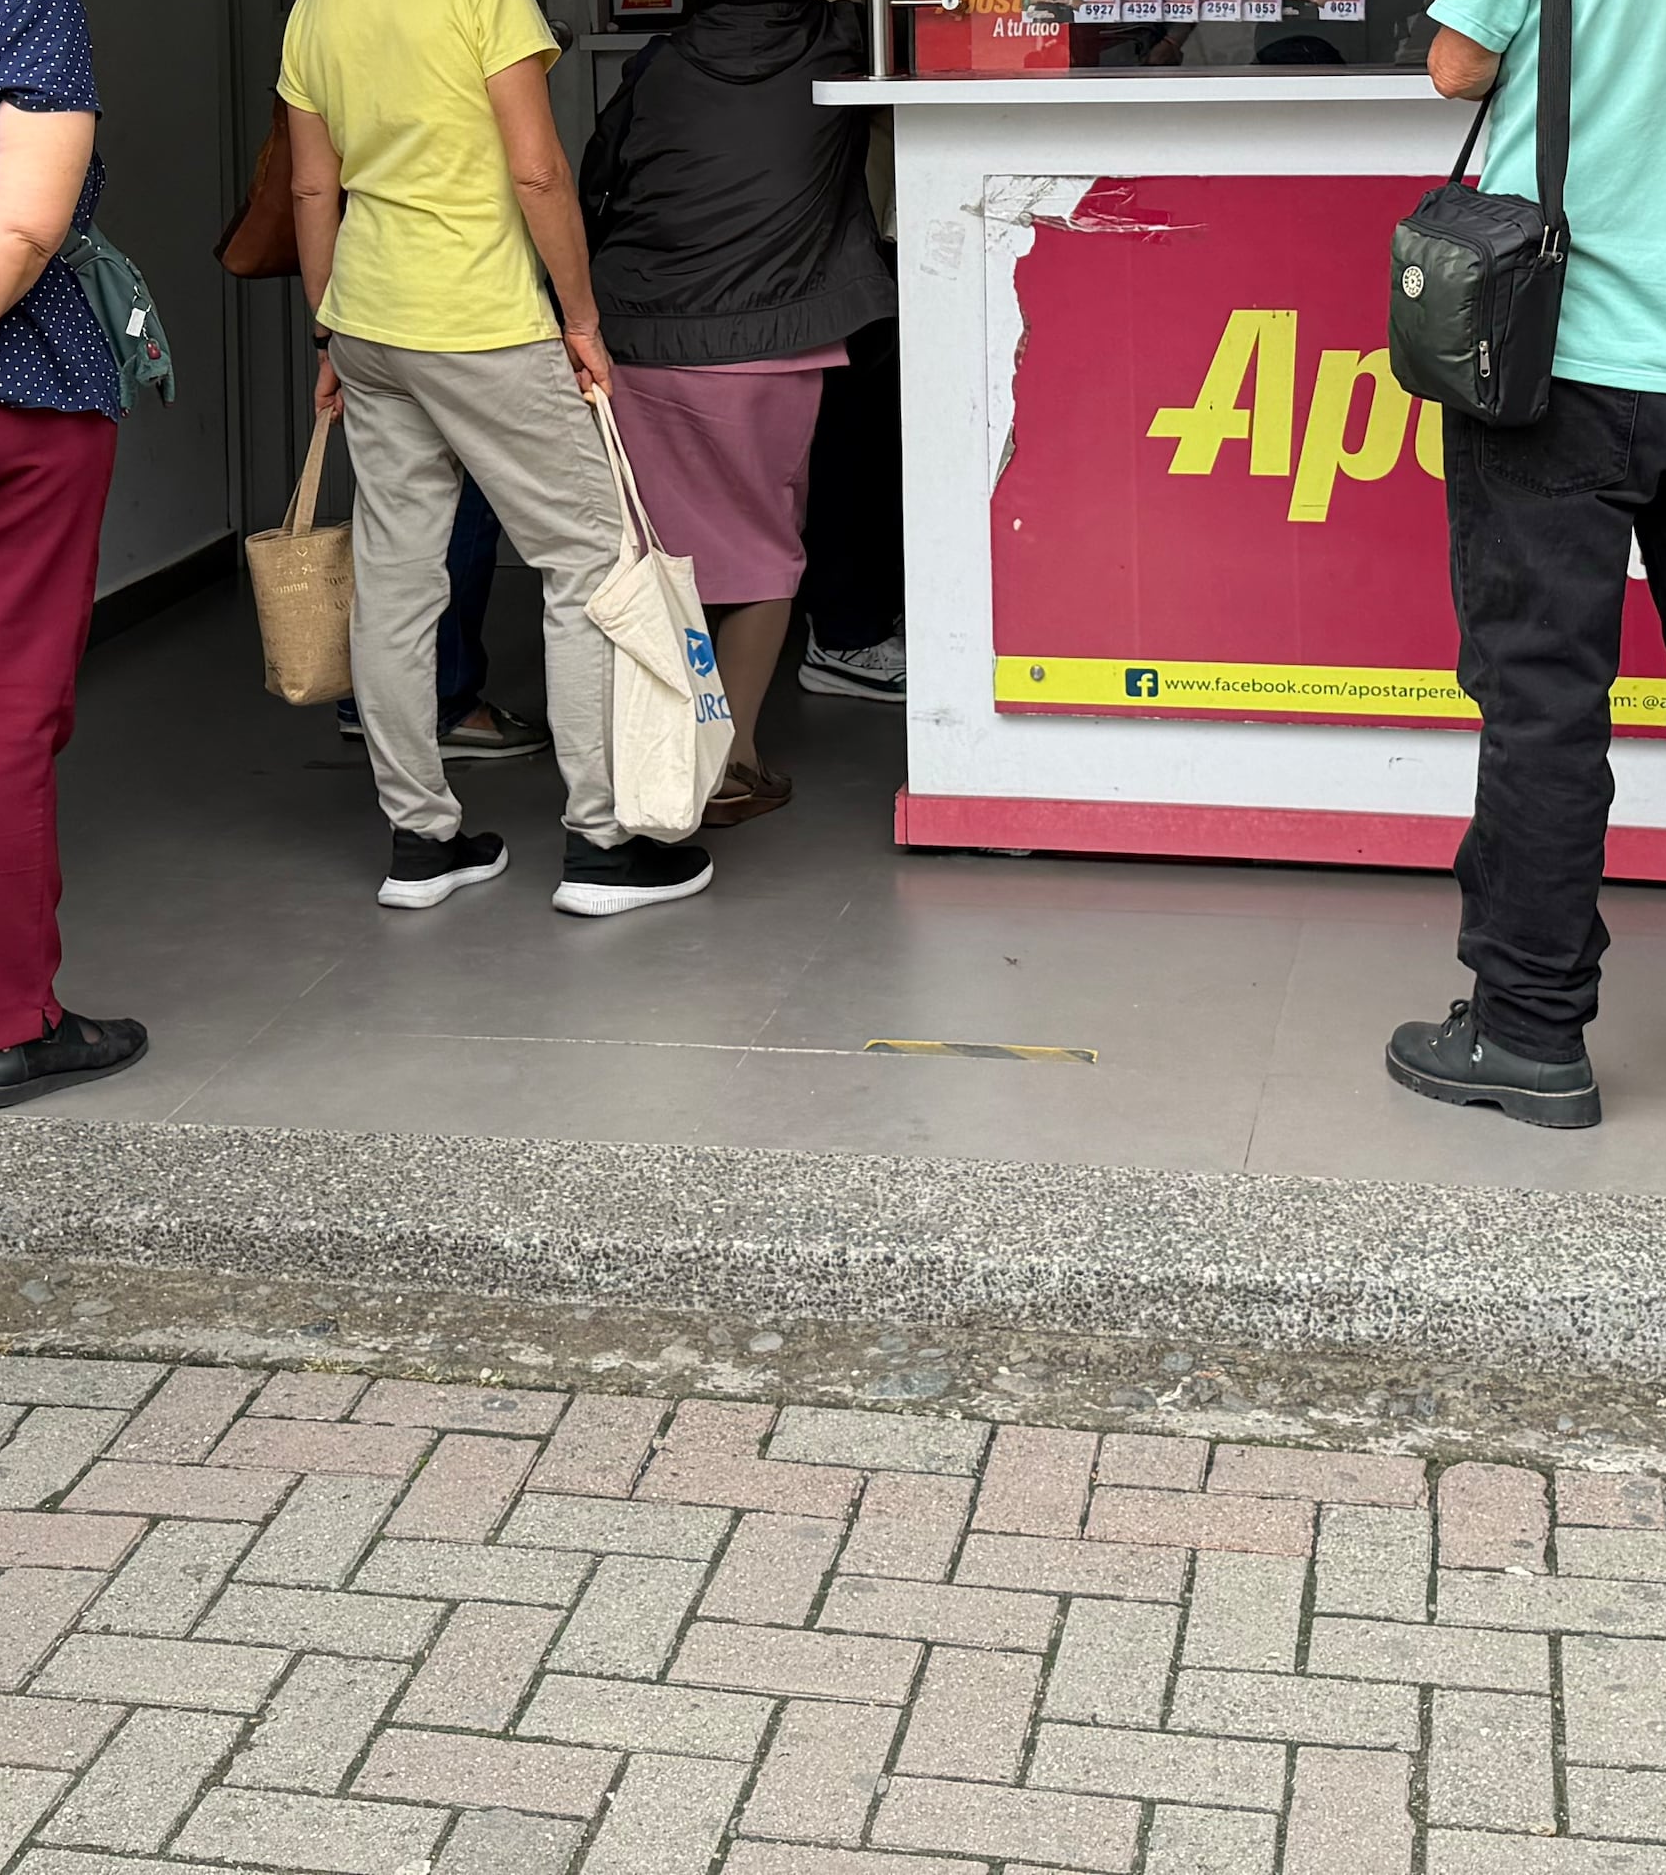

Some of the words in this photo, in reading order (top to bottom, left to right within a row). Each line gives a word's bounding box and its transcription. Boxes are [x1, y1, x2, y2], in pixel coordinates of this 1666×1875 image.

[1085, 4, 1114, 15] 5927
[1127, 3, 1157, 14] 4326
[1164, 3, 1193, 14] 3025
[1207, 2, 1236, 13] 2594
[1248, 2, 1276, 14] 1853
[1330, 2, 1357, 13] 8021
[993, 17, 1004, 37] A
[1166, 676, 1467, 702] www.facebook.com/apostarperei
